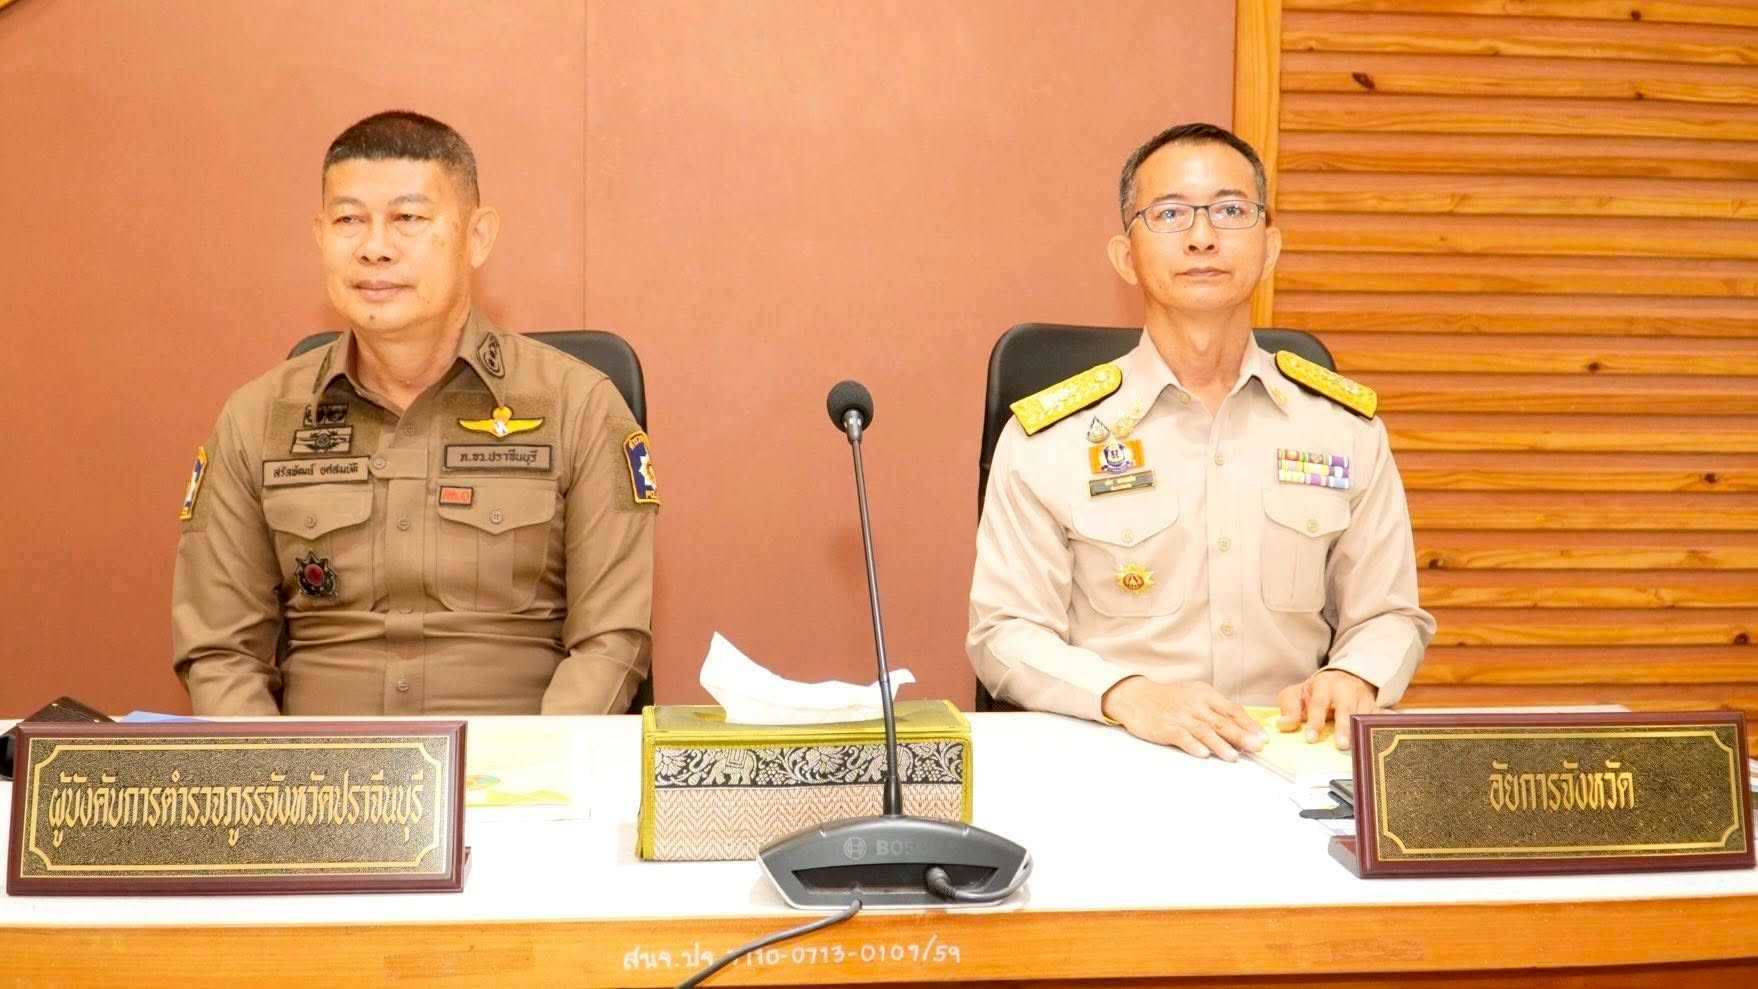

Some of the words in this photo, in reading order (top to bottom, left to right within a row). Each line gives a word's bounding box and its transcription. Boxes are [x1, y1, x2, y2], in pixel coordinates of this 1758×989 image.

[48, 769, 424, 848] ผู้บังคับการตำรวจภูธรจังหวัดปราจีนบุรี
[1489, 759, 1635, 811] อัยการจังหวัด
